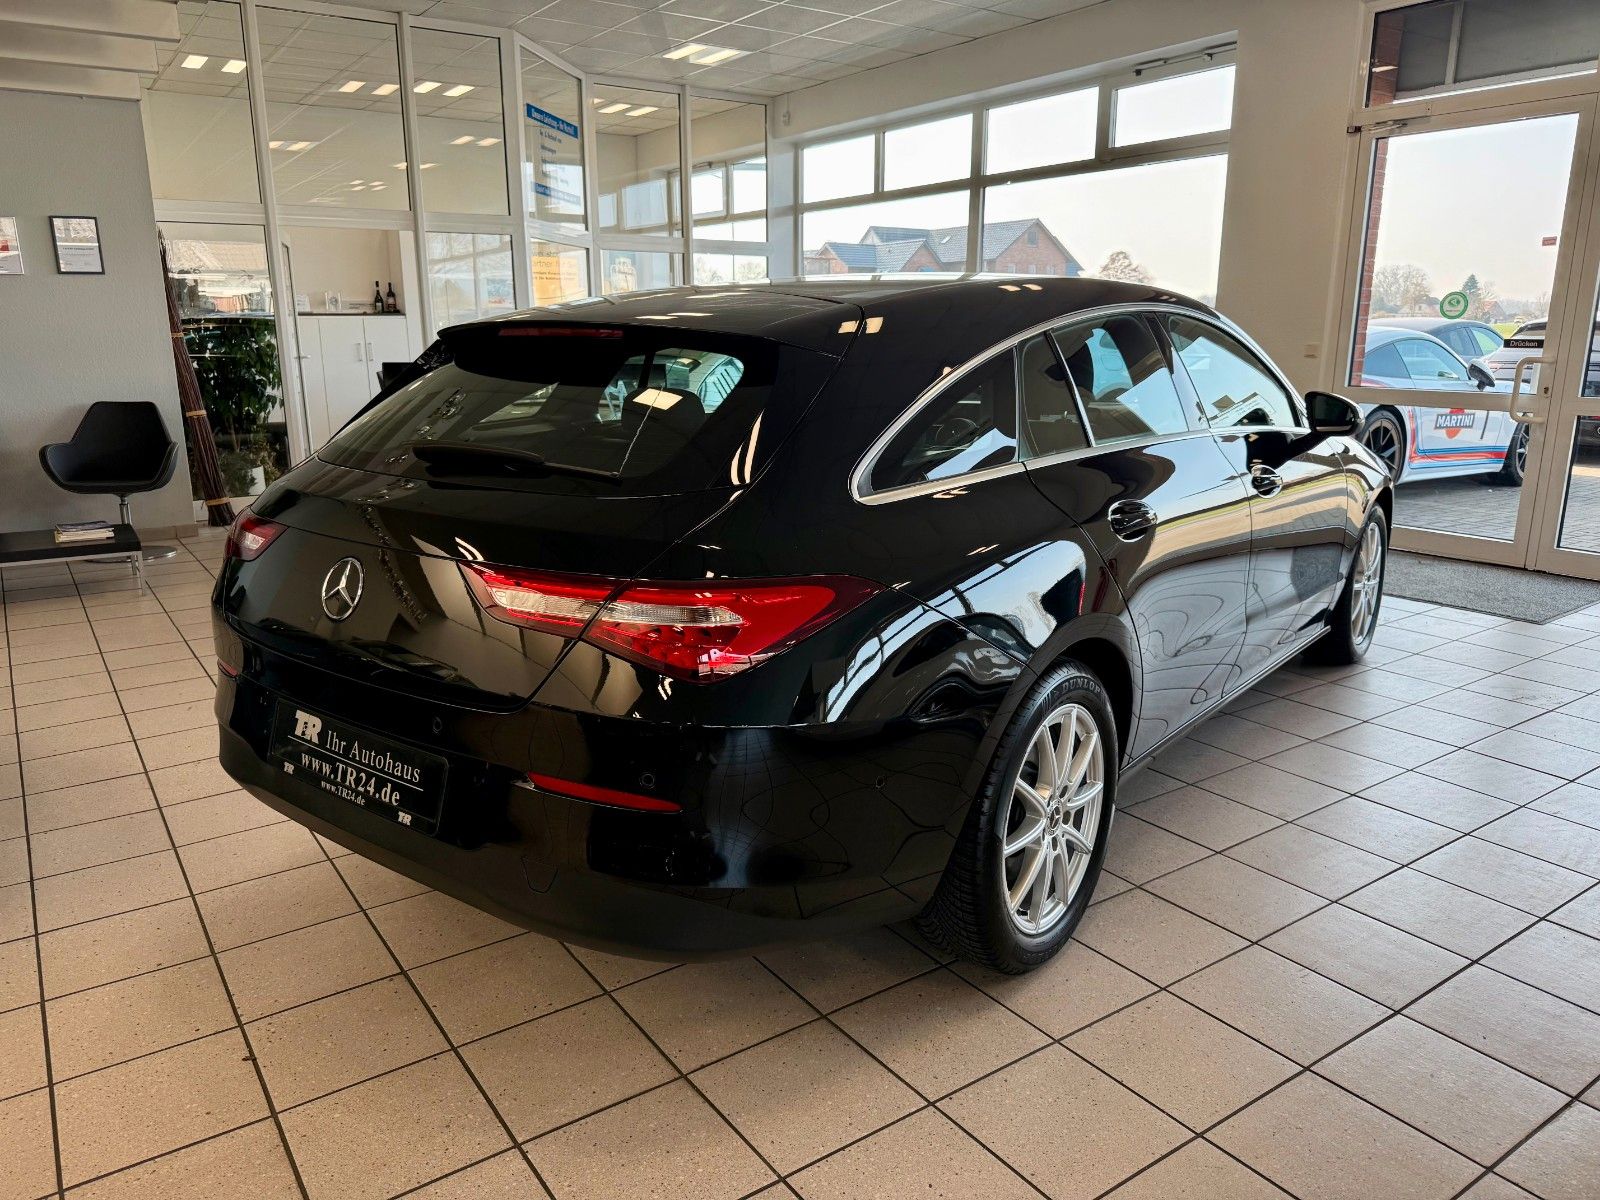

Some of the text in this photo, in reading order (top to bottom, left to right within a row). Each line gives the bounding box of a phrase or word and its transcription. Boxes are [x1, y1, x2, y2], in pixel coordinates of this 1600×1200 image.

[1510, 339, 1538, 348] Drücken
[1436, 414, 1474, 428] MARTINI
[1062, 678, 1101, 693] DUNLOP
[325, 730, 421, 783] Ihr Autohaus
[301, 753, 401, 806] www.TR24.de
[321, 780, 366, 806] www.TR24.de
